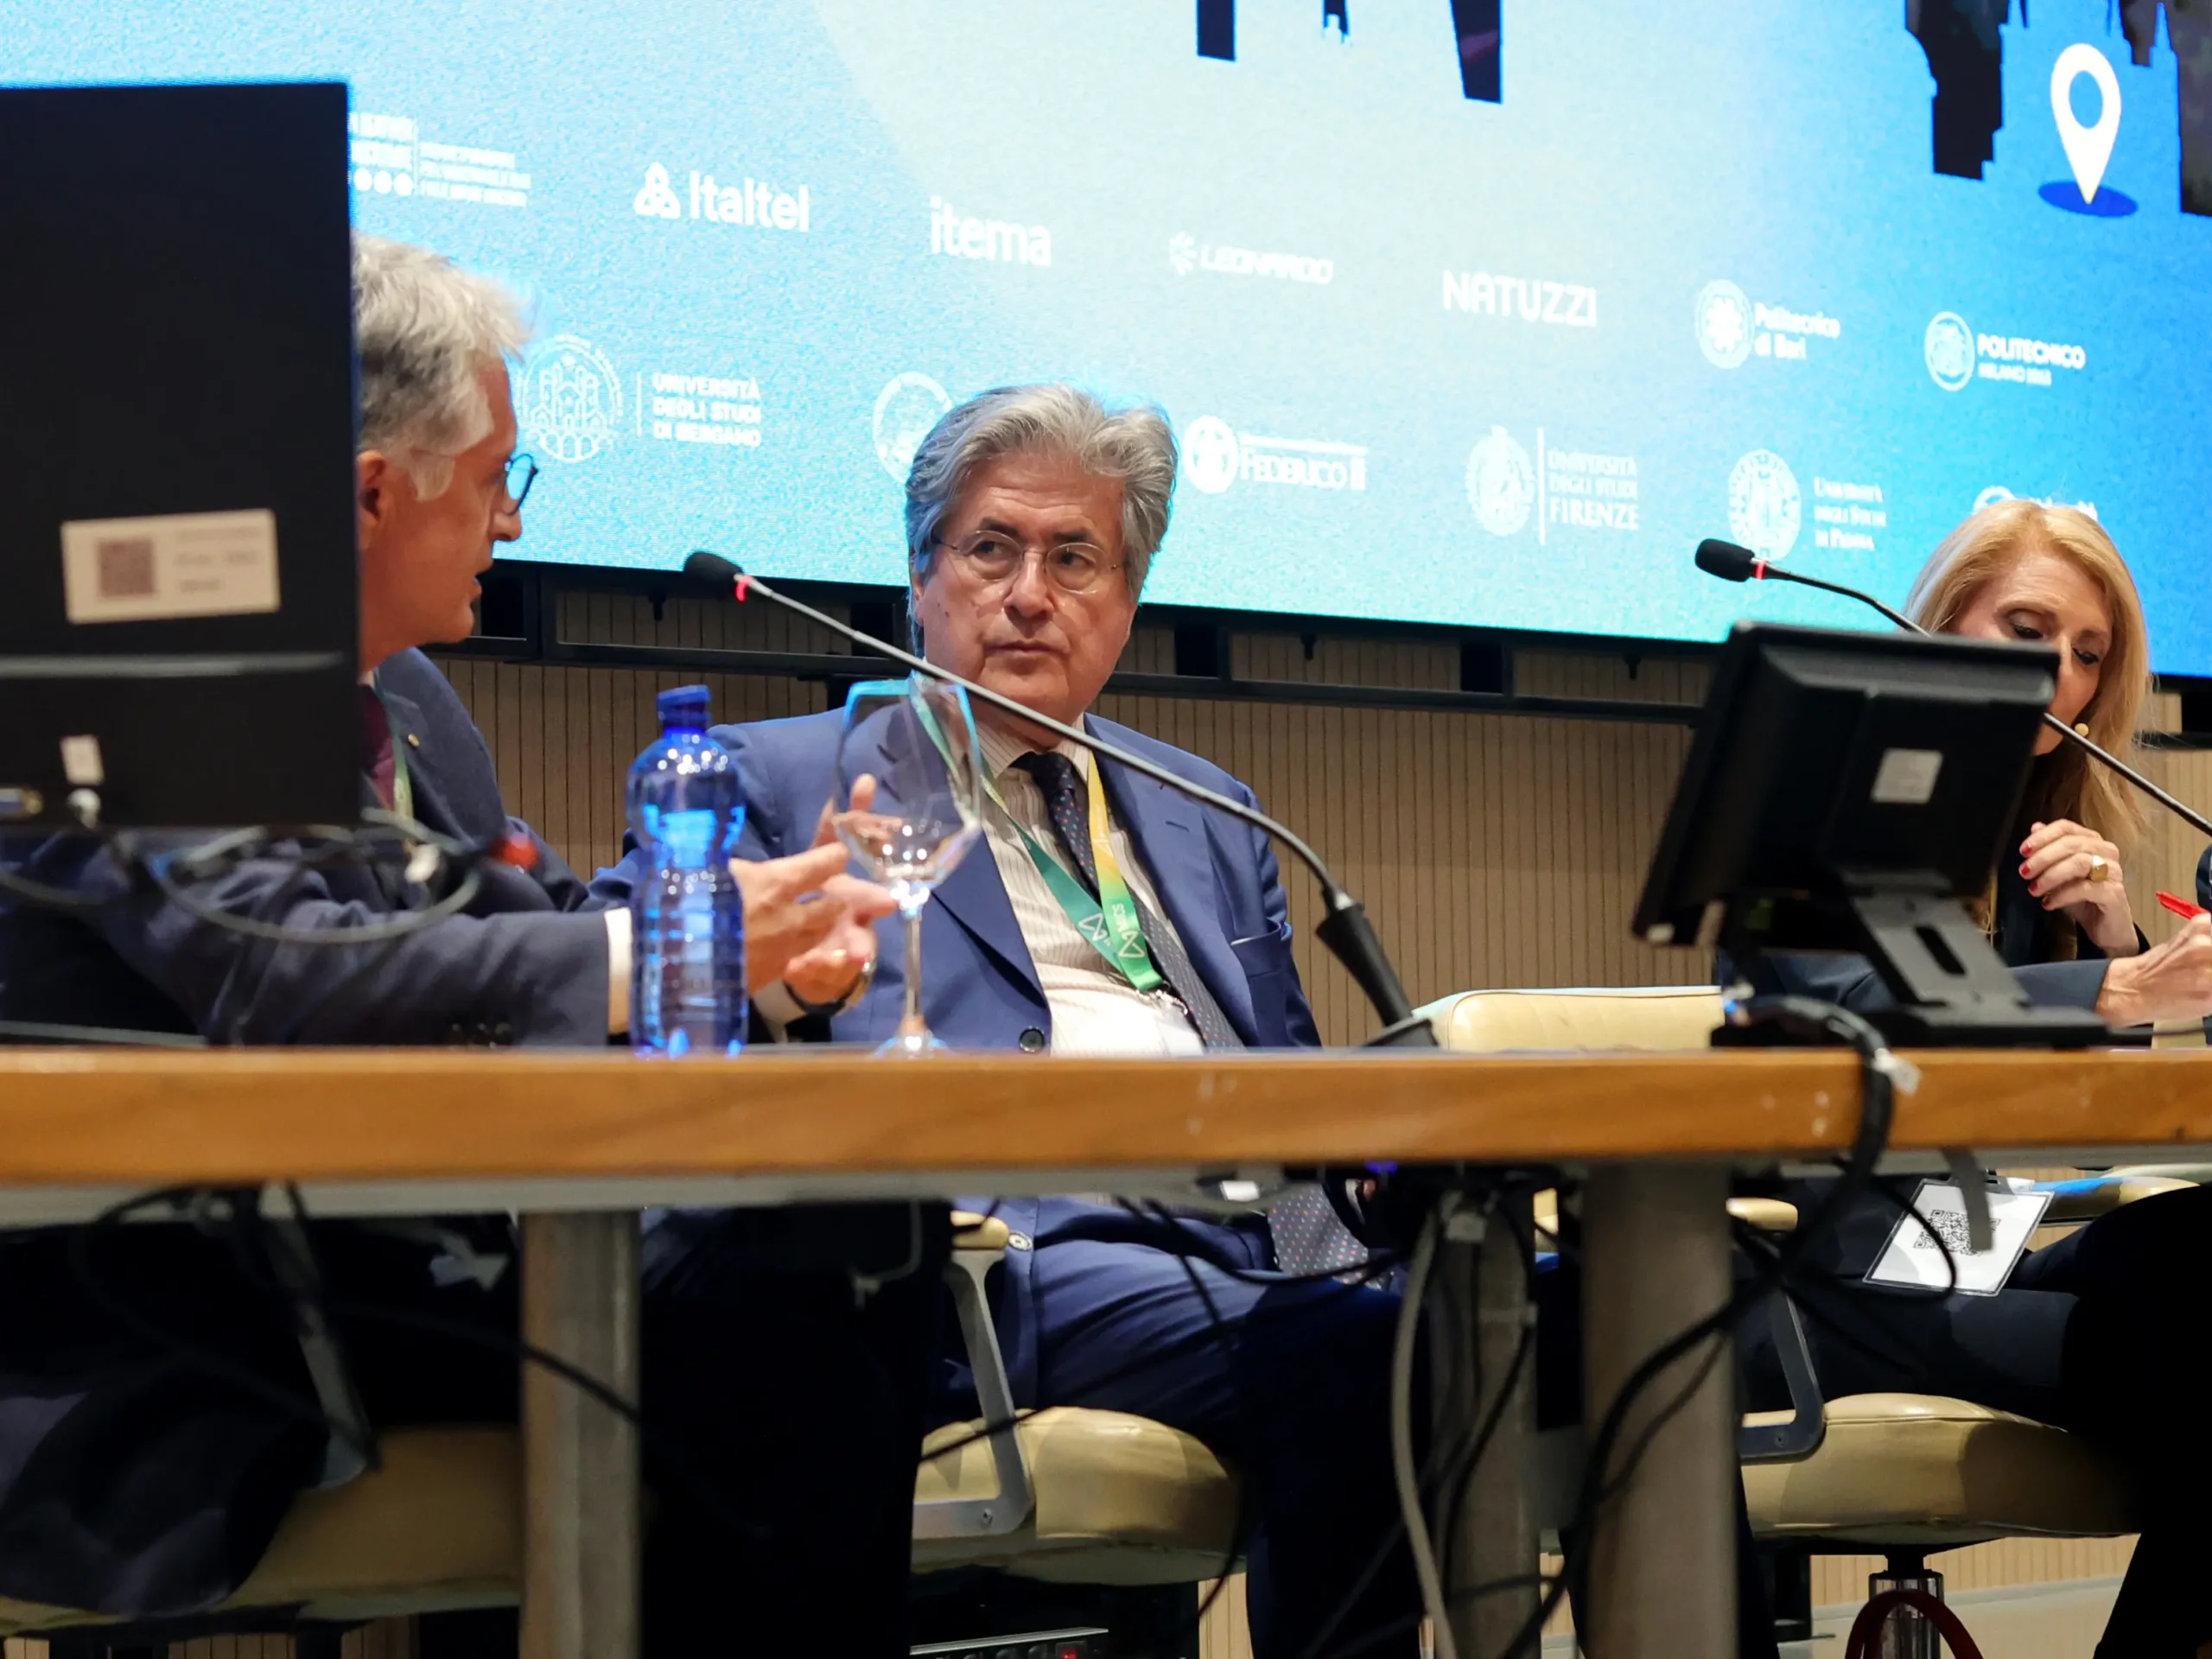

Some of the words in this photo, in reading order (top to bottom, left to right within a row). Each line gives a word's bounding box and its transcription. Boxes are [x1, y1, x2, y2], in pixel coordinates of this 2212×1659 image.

[690, 170, 809, 232] Italtel
[930, 196, 1052, 267] itema
[1442, 269, 1598, 327] NATUZZI
[1977, 333, 2086, 369] POLITECNICO
[1549, 495, 1640, 531] FIRENZE
